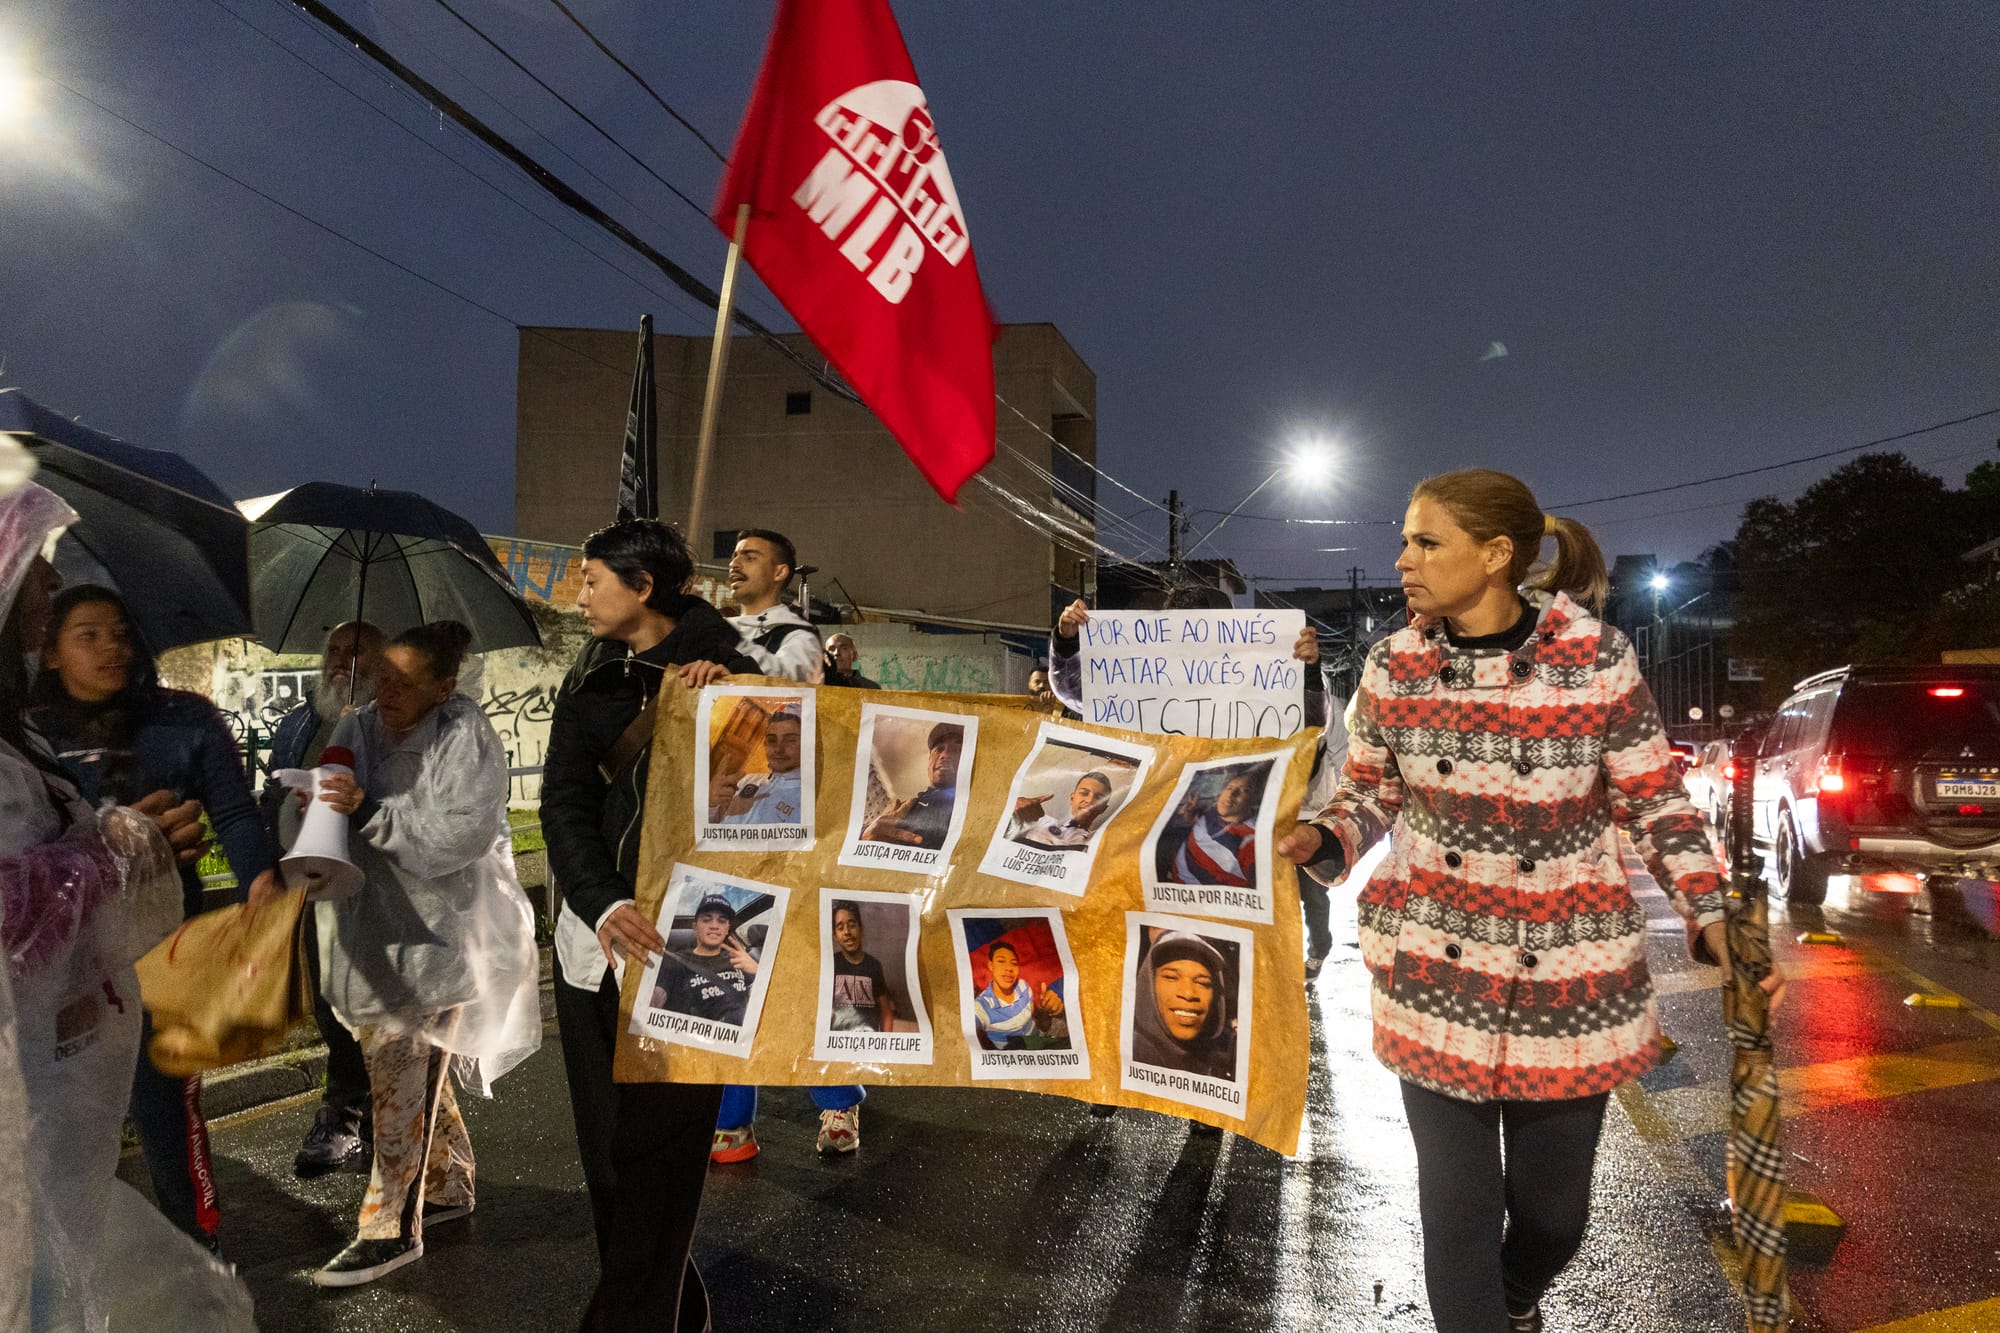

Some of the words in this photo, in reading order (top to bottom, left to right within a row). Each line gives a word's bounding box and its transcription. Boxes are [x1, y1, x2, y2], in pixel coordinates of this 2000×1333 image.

[791, 147, 925, 304] MLB
[1086, 618, 1129, 647] POR
[1135, 618, 1171, 645] QUE
[1181, 618, 1209, 643] AO
[1218, 613, 1276, 645] INVÉS
[1090, 657, 1173, 686] MATAR
[1181, 653, 1245, 685] VOCÊS
[1253, 659, 1298, 690] NÃO
[1093, 694, 1134, 724] DÃO
[702, 828, 739, 841] JUSTIÇA
[740, 829, 759, 840] POR
[761, 828, 808, 840] DALYSSON
[853, 845, 890, 860] JUSTIÇA
[891, 848, 912, 862] POR
[912, 852, 939, 864] ALEX
[1002, 857, 1024, 871] LUIS
[1153, 887, 1196, 904] JUSTIÇA
[1199, 890, 1221, 904] POR
[1224, 891, 1265, 910] RAFAEL
[647, 1012, 689, 1033] JUSTIÇA
[690, 1021, 713, 1038] POR
[713, 1027, 740, 1043] IVAN
[827, 1036, 865, 1052] JUSTIÇA
[868, 1037, 888, 1050] POR
[889, 1037, 921, 1051] FELIPE
[981, 1053, 1017, 1067] JUSTIÇA
[1017, 1054, 1037, 1066] POR
[1037, 1053, 1079, 1066] GUSTAVO
[1128, 1065, 1167, 1086] JUSTIÇA
[1169, 1075, 1190, 1091] POR
[1192, 1080, 1240, 1104] MARCELO
